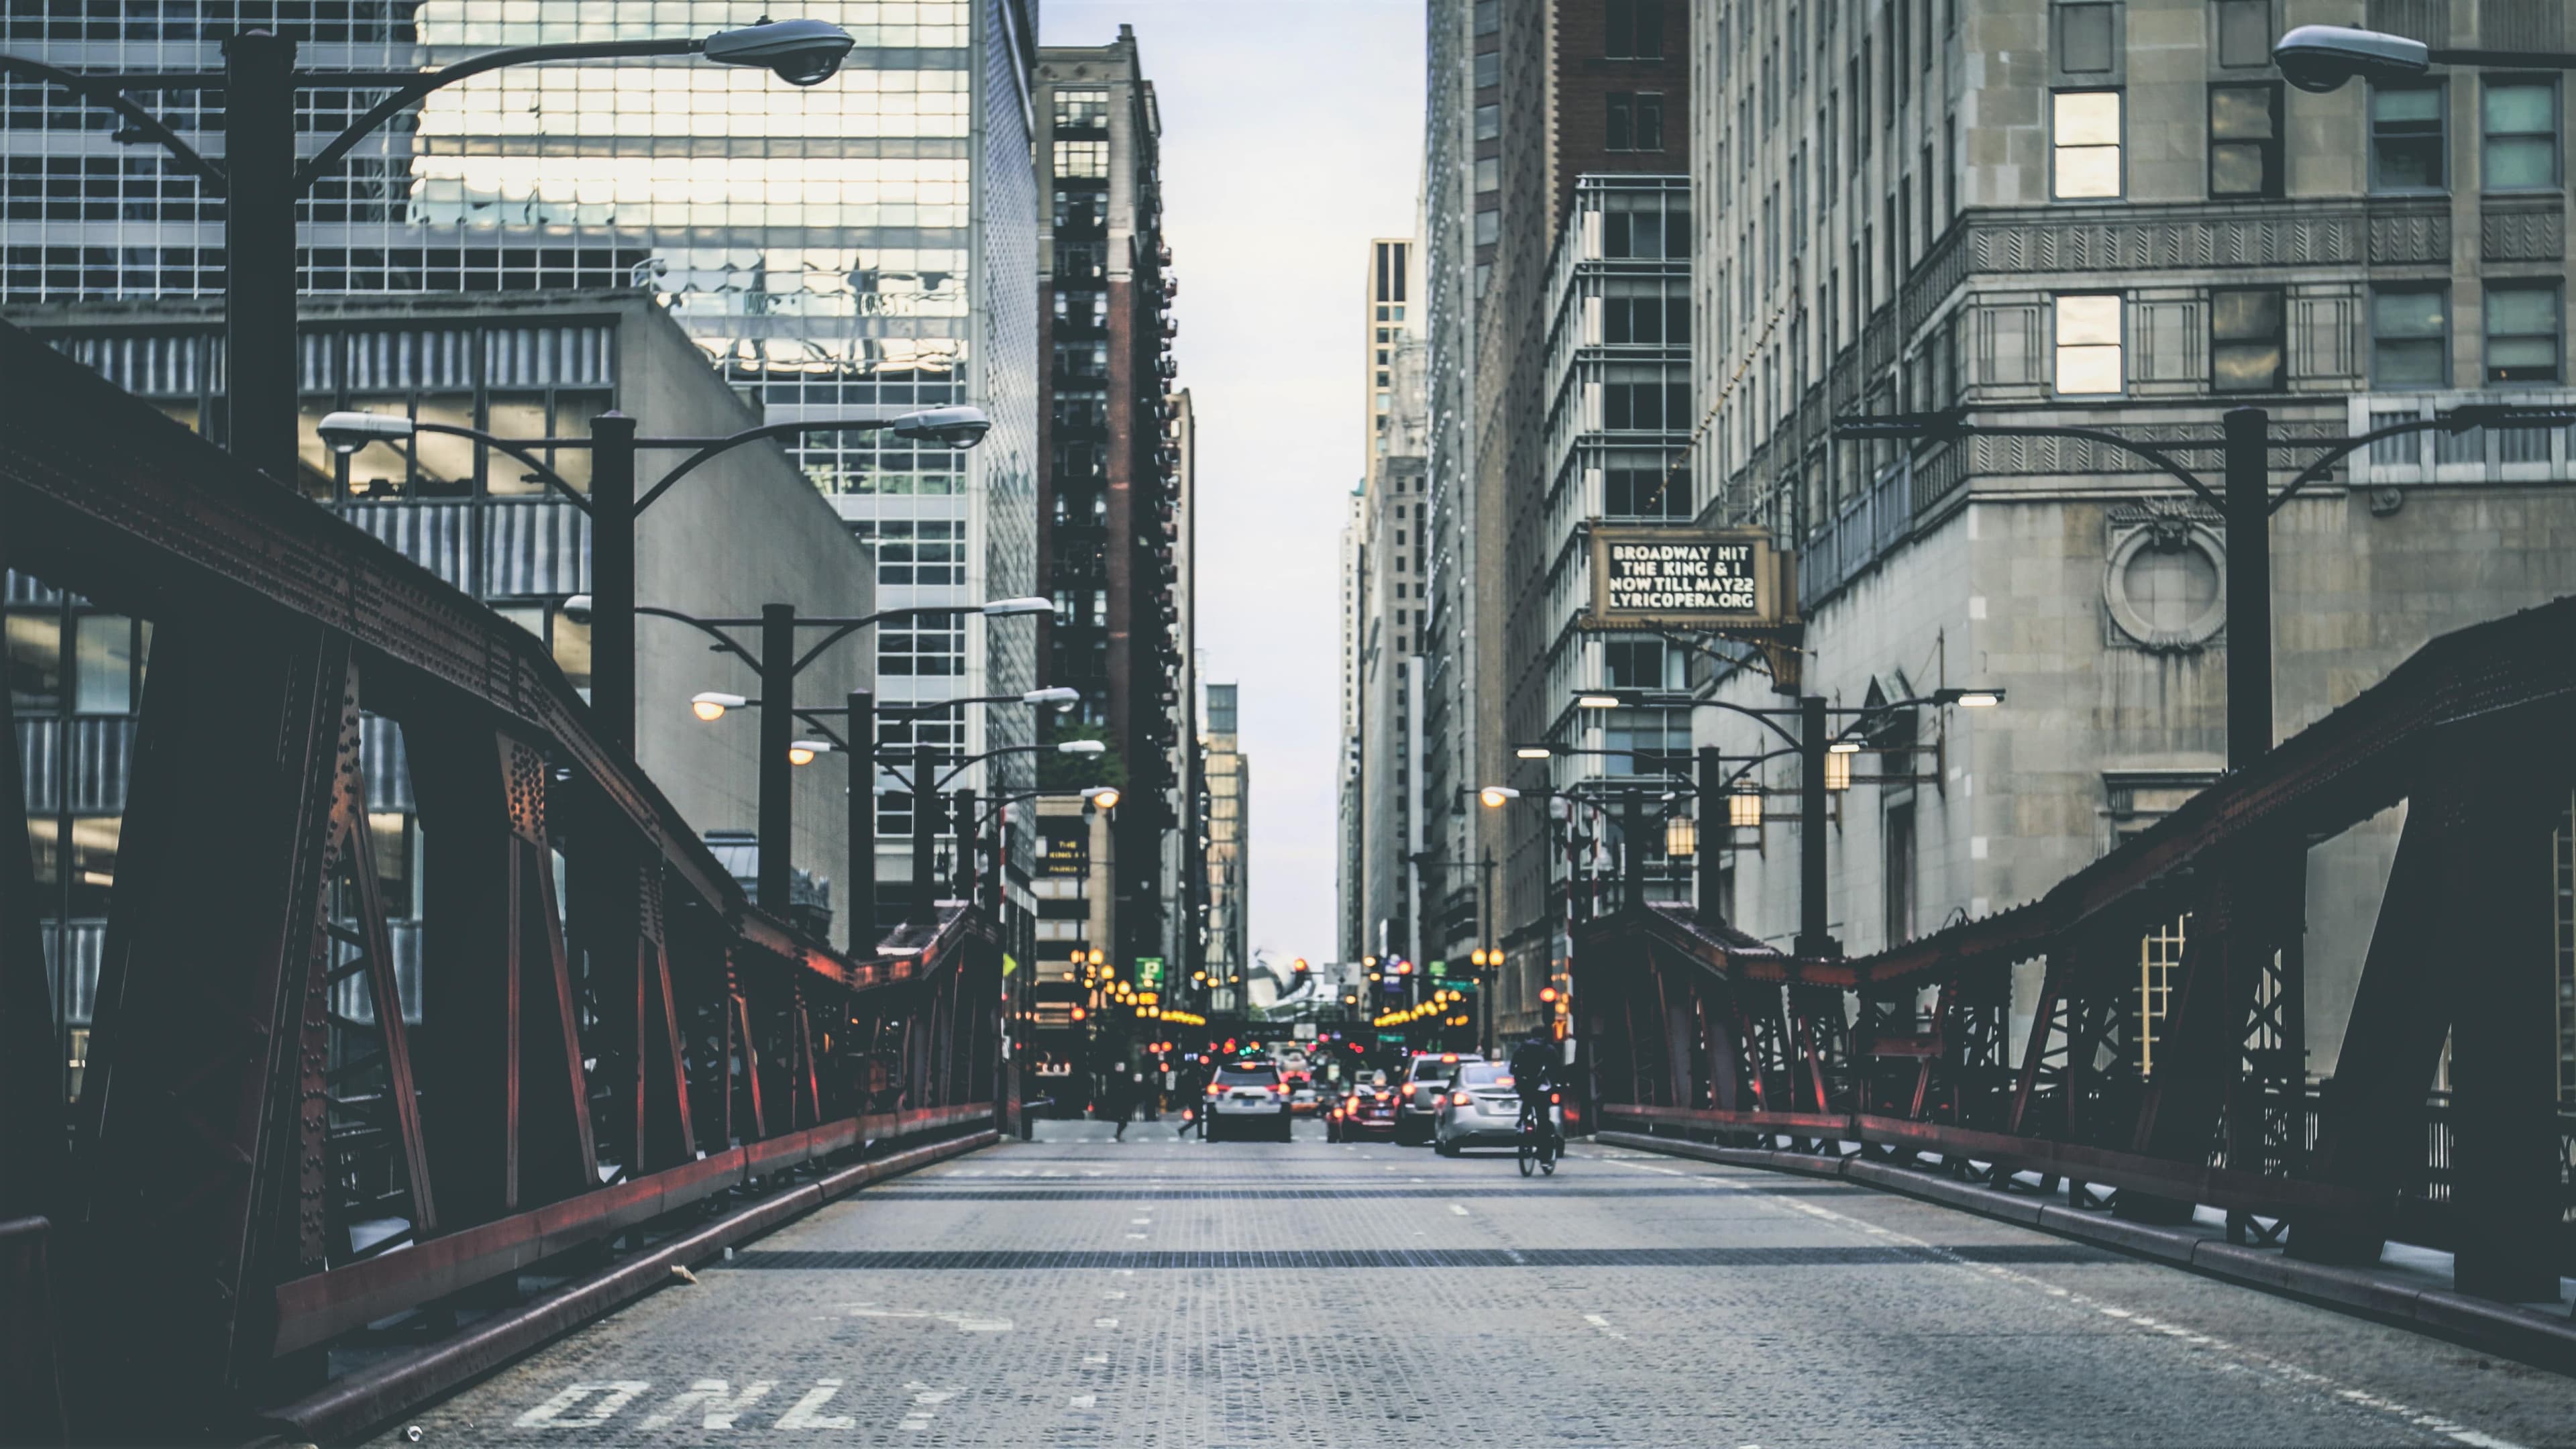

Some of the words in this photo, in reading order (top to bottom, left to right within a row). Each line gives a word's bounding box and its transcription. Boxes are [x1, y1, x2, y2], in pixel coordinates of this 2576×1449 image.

[1613, 545, 1711, 561] BROADWAY
[1718, 545, 1749, 561] HIT
[1621, 561, 1657, 576] THE
[1662, 561, 1709, 577] KING
[1713, 561, 1728, 576] &
[1734, 562, 1741, 576] I
[1610, 578, 1652, 592] NOW
[1653, 578, 1693, 592] TILL
[1610, 593, 1754, 608] LYRICOPERA.ORG
[513, 1380, 967, 1430] ONLY
